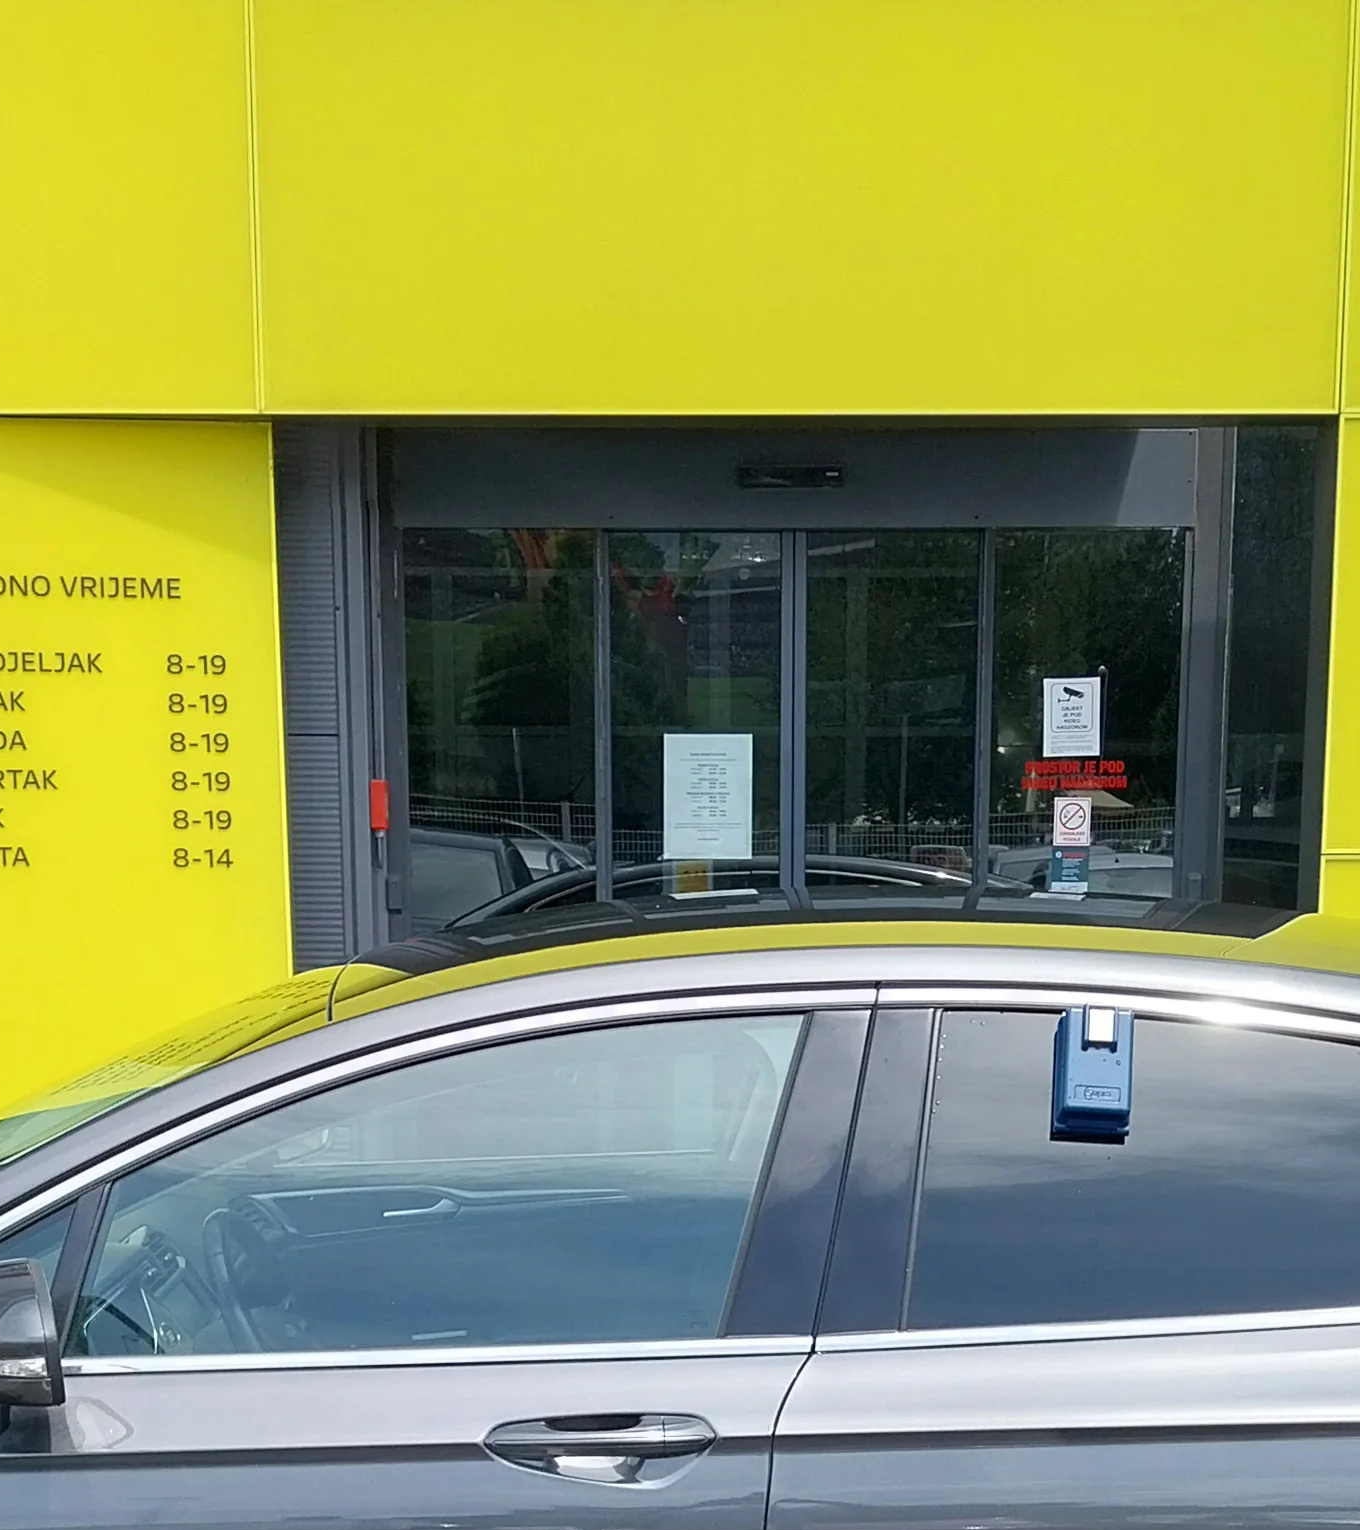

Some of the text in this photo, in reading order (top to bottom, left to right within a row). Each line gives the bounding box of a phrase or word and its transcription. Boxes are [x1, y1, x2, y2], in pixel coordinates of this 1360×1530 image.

[60, 576, 180, 599] VRIJEME
[167, 654, 226, 675] 8-19
[169, 694, 227, 714] 8-19
[170, 733, 228, 753] 8-19
[1025, 760, 1125, 774] PROSTOR JE POD
[172, 771, 230, 791] 8-19
[173, 810, 231, 830] 8-19
[174, 848, 233, 868] 8-14
